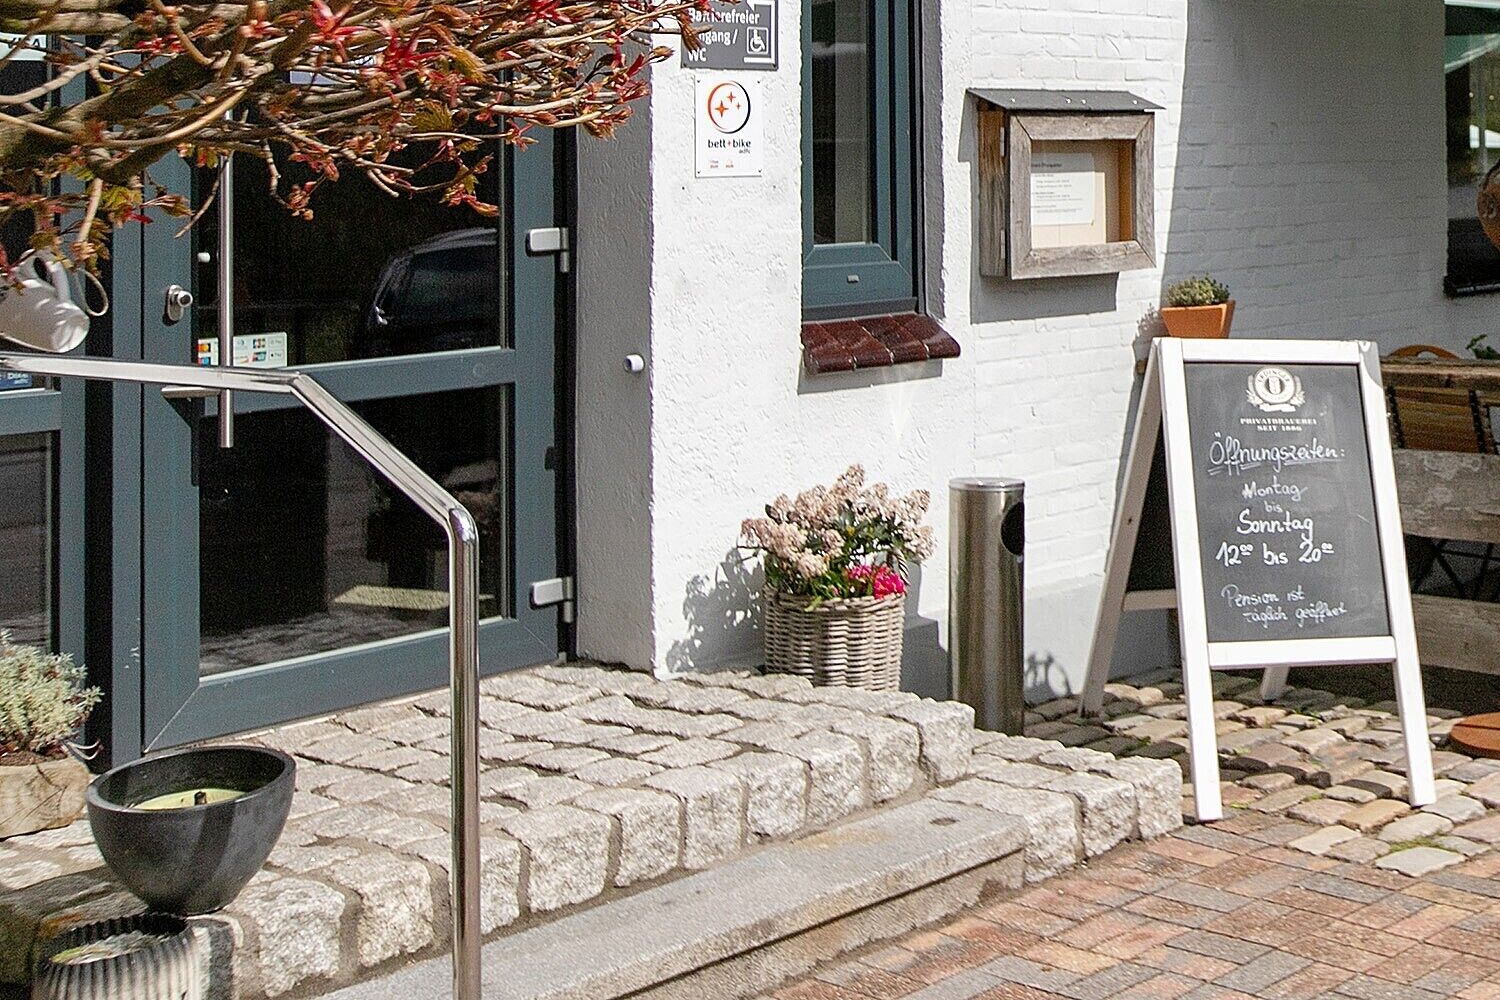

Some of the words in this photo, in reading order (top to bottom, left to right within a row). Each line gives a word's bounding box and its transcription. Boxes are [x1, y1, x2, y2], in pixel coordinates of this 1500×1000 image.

[688, 47, 707, 62] WC
[1209, 431, 1346, 476] Öffnungszeiten:
[1242, 475, 1308, 501] Montag
[1264, 501, 1284, 514] bis
[1237, 509, 1314, 543] Sonntag
[1263, 542, 1289, 565] bis
[1221, 584, 1280, 608] Pension
